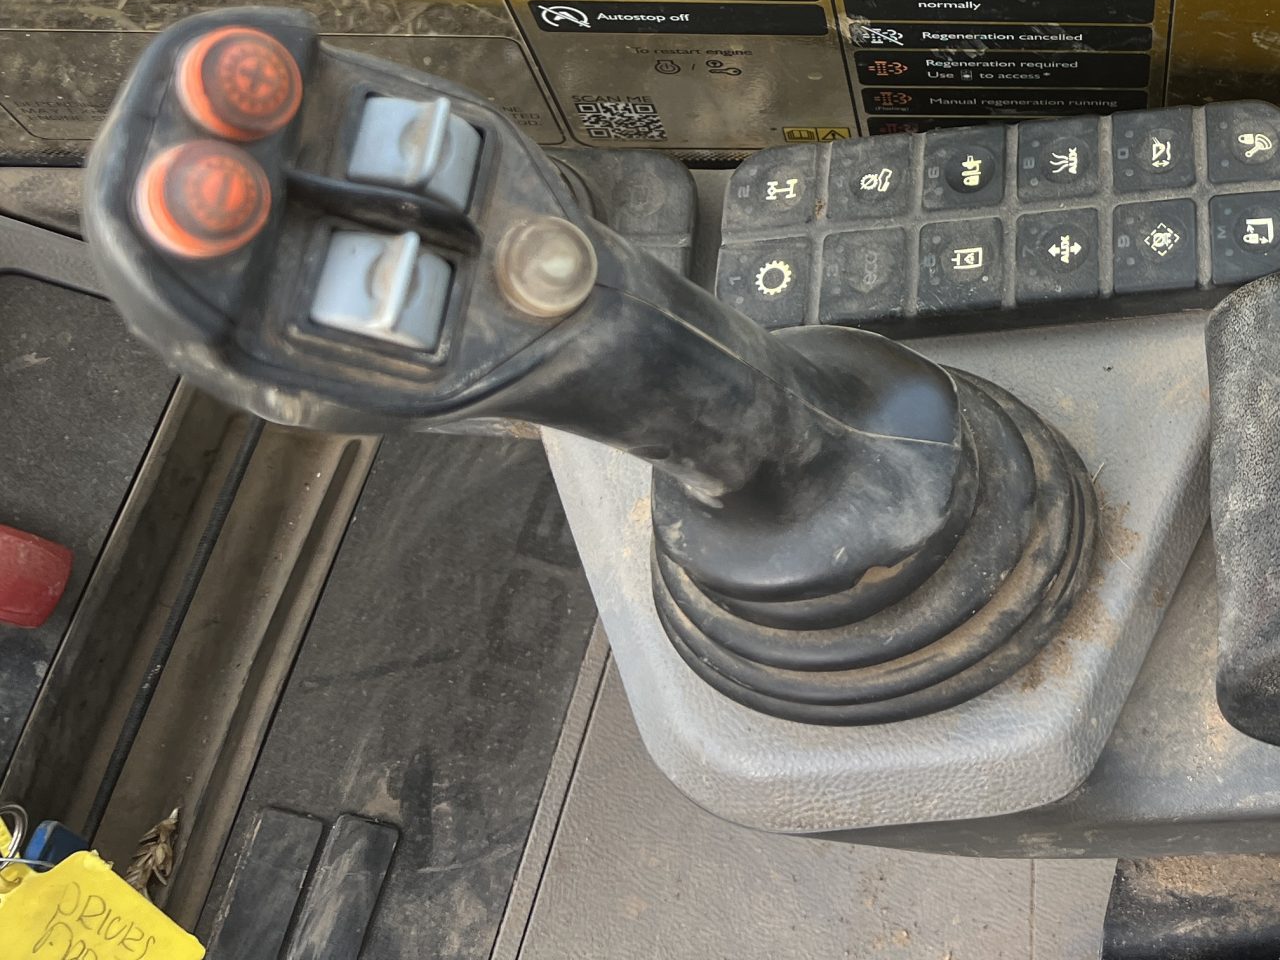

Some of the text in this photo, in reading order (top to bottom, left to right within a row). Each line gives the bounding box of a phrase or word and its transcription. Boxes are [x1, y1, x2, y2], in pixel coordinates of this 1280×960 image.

[917, 0, 982, 11] normally
[597, 12, 691, 23] Autostop off
[921, 30, 1084, 43] Regeneration cancelled
[634, 47, 753, 57] To restart engine
[925, 59, 1079, 71] Regeneration required
[926, 71, 955, 80] Use
[570, 95, 651, 104] SCAN ME
[929, 96, 1118, 109] Manual regeneration running
